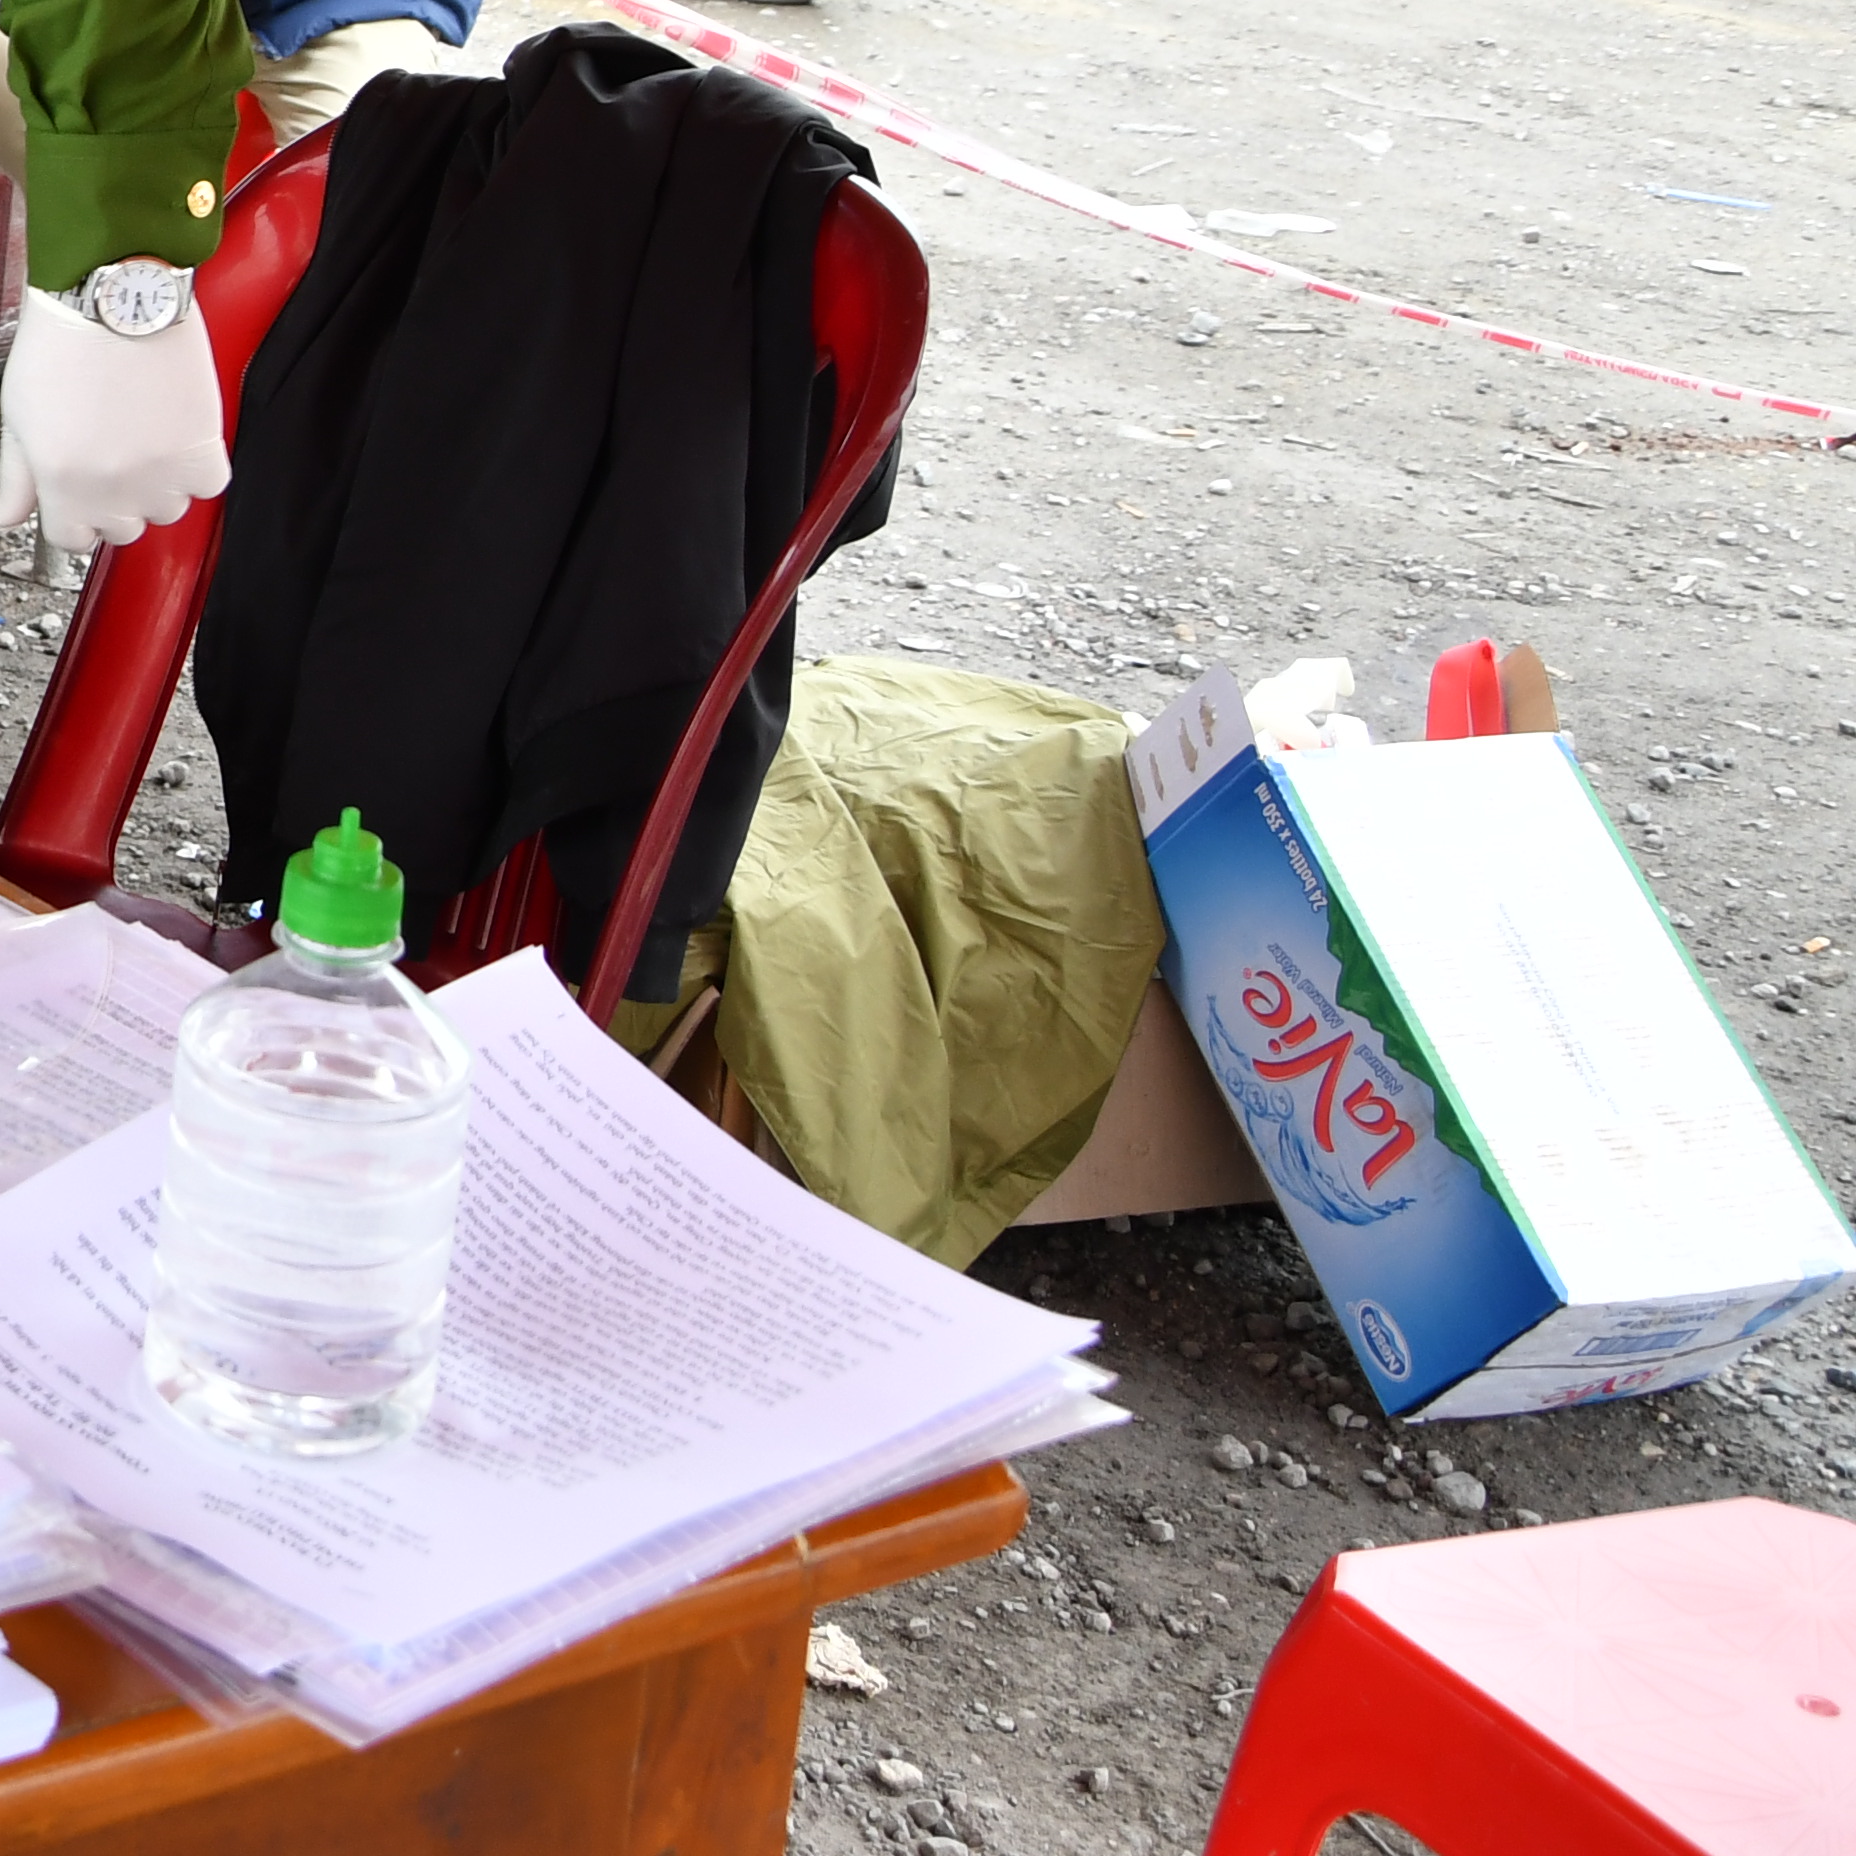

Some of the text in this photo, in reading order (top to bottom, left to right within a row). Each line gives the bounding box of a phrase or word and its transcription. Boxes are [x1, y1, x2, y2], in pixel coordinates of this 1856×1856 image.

[1254, 782, 1271, 802] ml
[1262, 797, 1287, 831] 350
[1289, 837, 1320, 894] bottles
[1309, 886, 1327, 914] 24
[1268, 943, 1404, 1097] Natural Mineral Water
